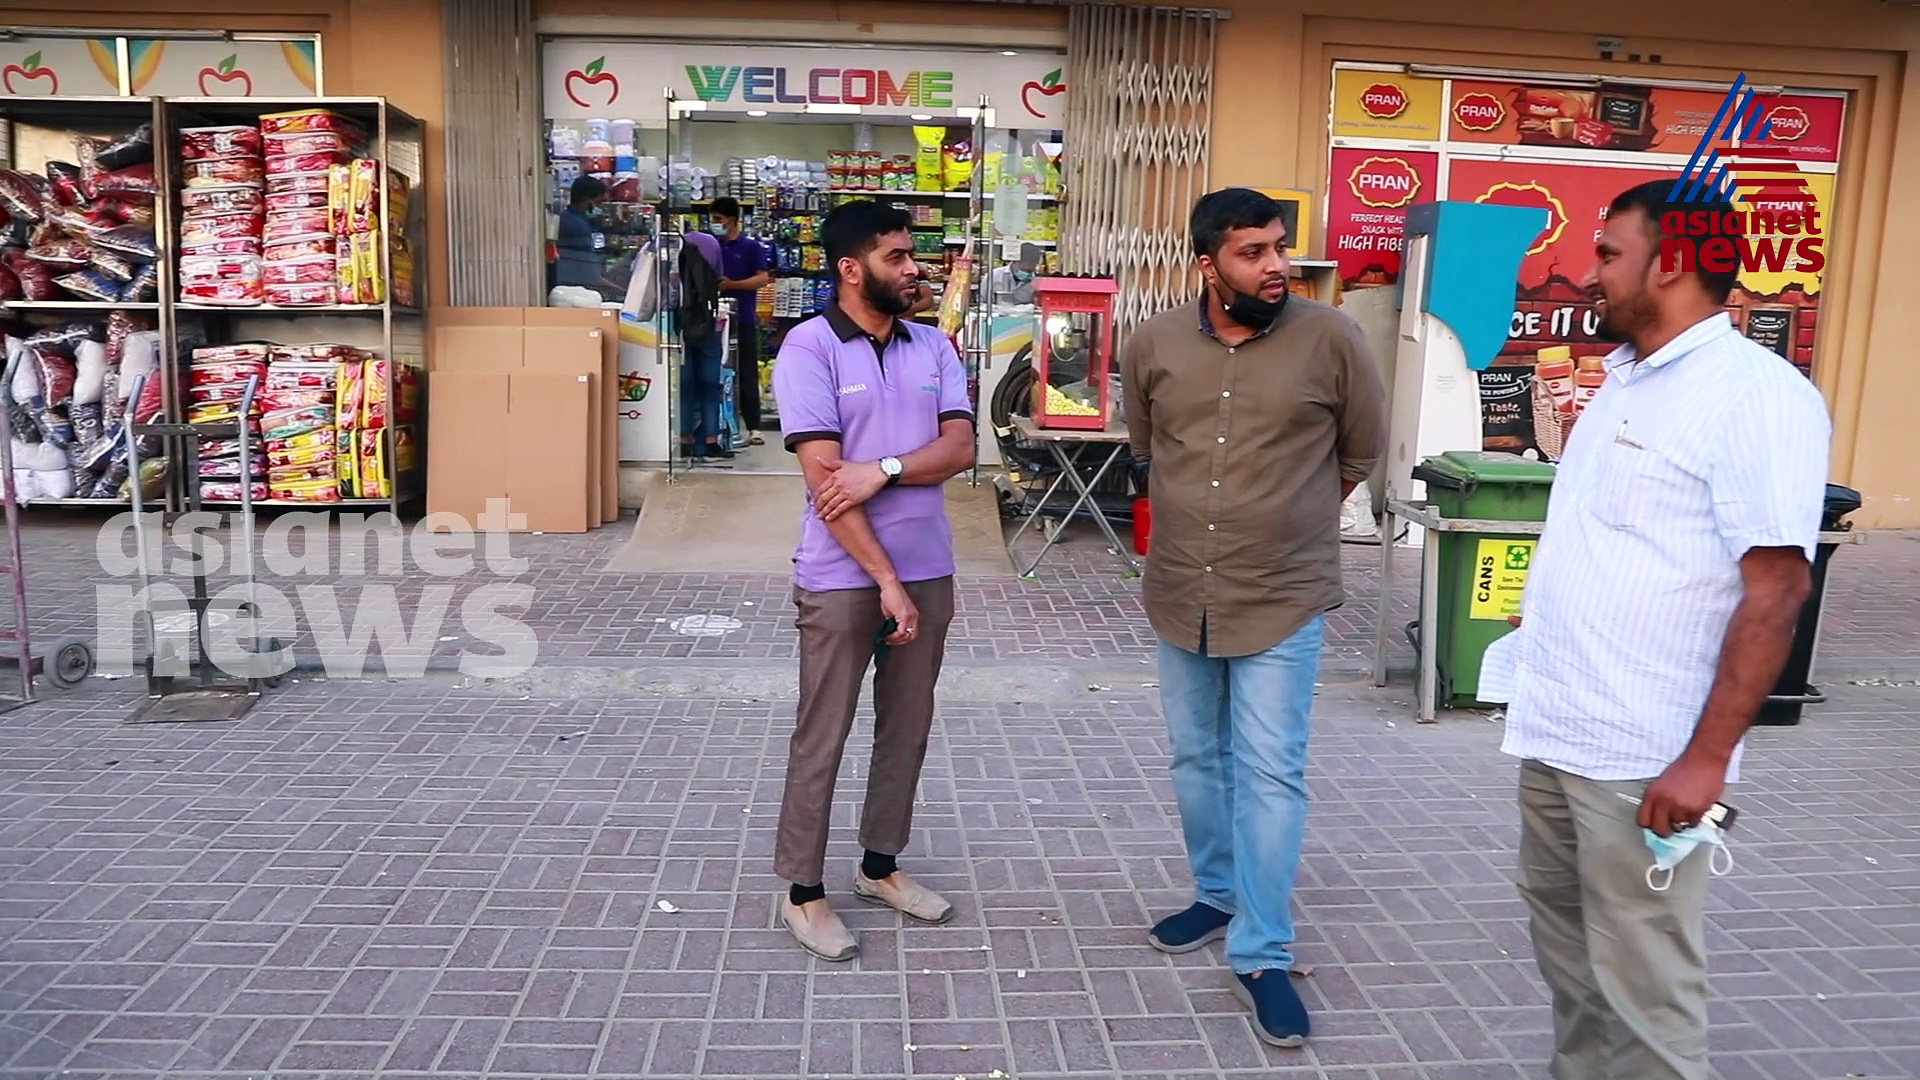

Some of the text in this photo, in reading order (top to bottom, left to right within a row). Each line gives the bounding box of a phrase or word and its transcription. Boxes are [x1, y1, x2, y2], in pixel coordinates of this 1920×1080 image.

[685, 65, 953, 107] WELCOME
[1365, 93, 1401, 106] PRAN
[1459, 104, 1498, 118] PRAN
[1771, 117, 1804, 129] PRAN
[1358, 173, 1410, 190] PRAN
[1350, 213, 1383, 223] PERFECT
[1361, 225, 1386, 234] SNACK
[1338, 234, 1403, 251] HIGH FIBE
[1508, 311, 1542, 338] CE
[1550, 307, 1575, 337] IT
[1481, 373, 1512, 383] PRAN
[1477, 556, 1495, 603] CANS
